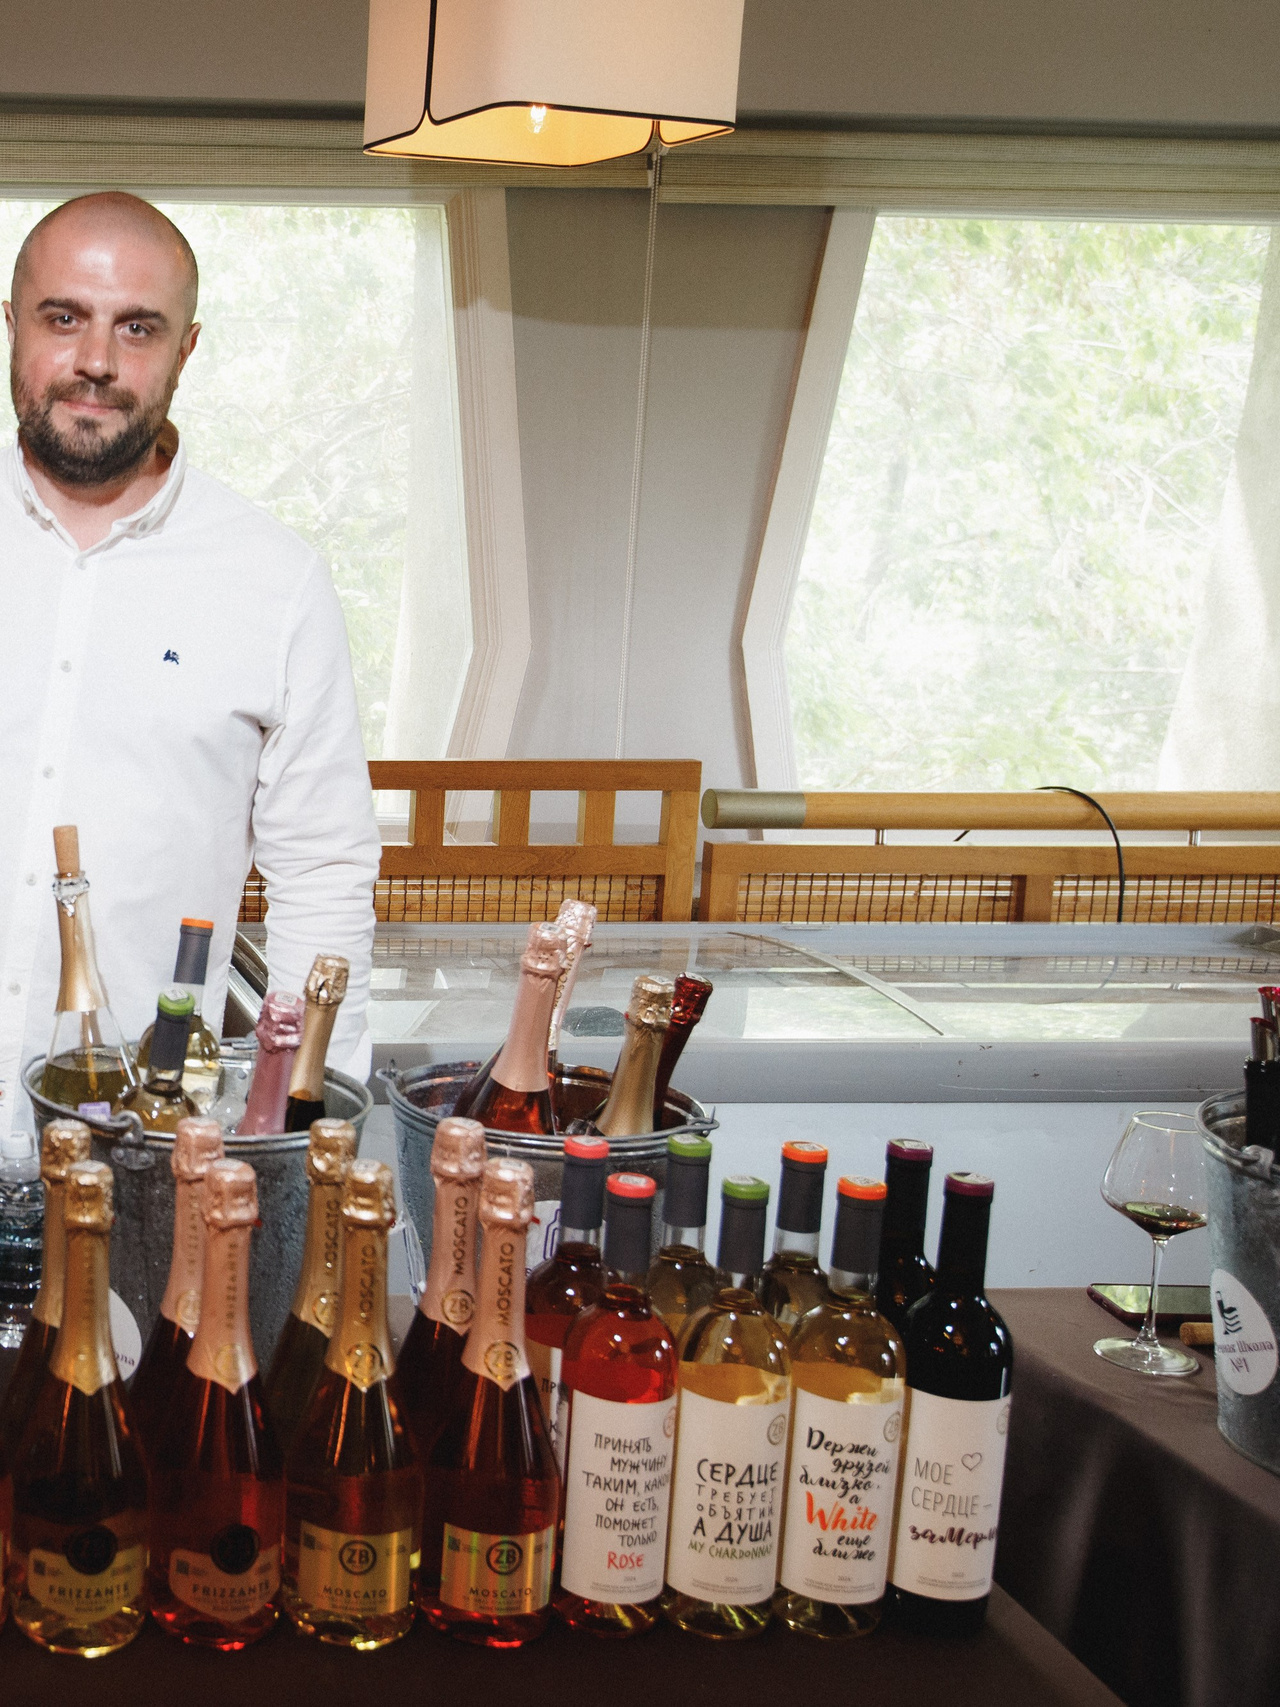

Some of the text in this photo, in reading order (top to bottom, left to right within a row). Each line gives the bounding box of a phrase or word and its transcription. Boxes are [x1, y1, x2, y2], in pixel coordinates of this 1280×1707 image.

[452, 1195, 469, 1276] MOSCATO
[496, 1241, 515, 1327] MOSCATO
[1236, 1340, 1274, 1352] Школа
[594, 1432, 652, 1454] ПРИНЯТЬ
[805, 1426, 878, 1458] Держи
[610, 1454, 668, 1474] МУЖЧИНУ
[696, 1458, 779, 1488] СЕРДЦЕ
[831, 1458, 890, 1479] друзей
[914, 1457, 954, 1486] МОЕ
[582, 1470, 640, 1497] ТАКИМ,
[695, 1483, 777, 1504] ТРЕБУЕТ
[848, 1494, 860, 1505] а
[911, 1486, 979, 1519] СЕРДЦЕ
[605, 1497, 624, 1512] ОН
[805, 1490, 878, 1531] White
[595, 1513, 656, 1532] ПОМОЖЕТ
[693, 1516, 772, 1545] А ДУША
[617, 1530, 658, 1548] ТОЛЬКО
[688, 1539, 705, 1554] MY
[347, 1549, 369, 1565] ZB
[494, 1549, 516, 1565] ZB
[607, 1551, 644, 1570] ROSE
[48, 1582, 130, 1599] FRIZZANTE
[192, 1579, 270, 1597] FRIZZANTE
[323, 1585, 387, 1598] MOSCATO
[469, 1587, 532, 1598] MOSCATO
